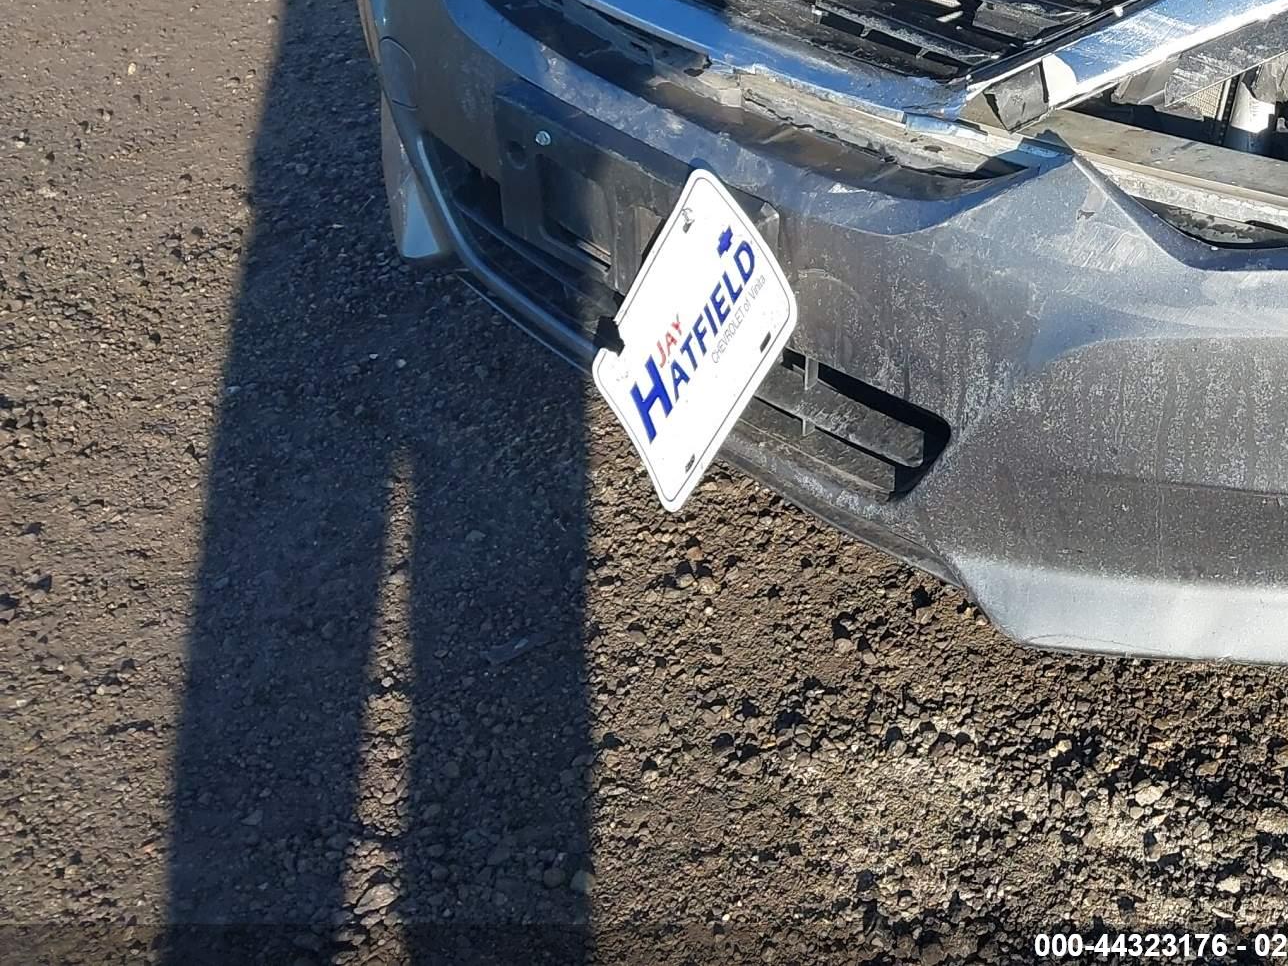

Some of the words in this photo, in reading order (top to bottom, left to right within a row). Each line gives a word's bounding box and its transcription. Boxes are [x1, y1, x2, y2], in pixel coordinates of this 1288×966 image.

[630, 240, 756, 445] HATFIELD
[657, 314, 683, 368] JAY
[711, 305, 745, 364] CHEVROLET
